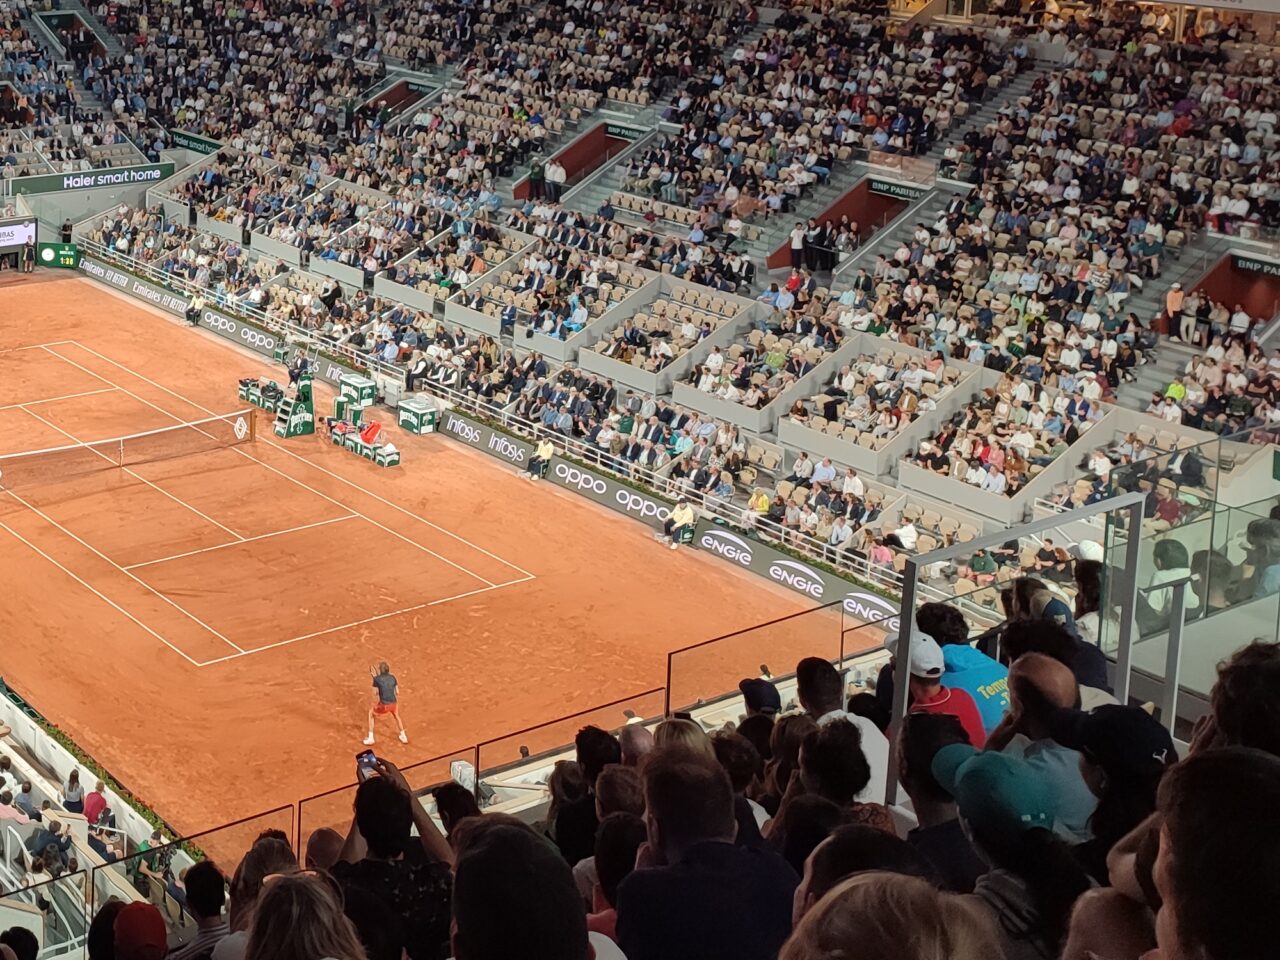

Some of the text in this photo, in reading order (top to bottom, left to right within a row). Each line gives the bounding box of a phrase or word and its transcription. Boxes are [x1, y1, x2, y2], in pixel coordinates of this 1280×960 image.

[63, 169, 161, 189] Haier smart home
[79, 258, 105, 277] Emirates
[132, 281, 161, 303] Emirates
[1238, 259, 1261, 271] BNP
[204, 311, 274, 349] oppo oppo
[446, 415, 526, 461] Infosys Infosys
[555, 463, 670, 521] oppo oppo
